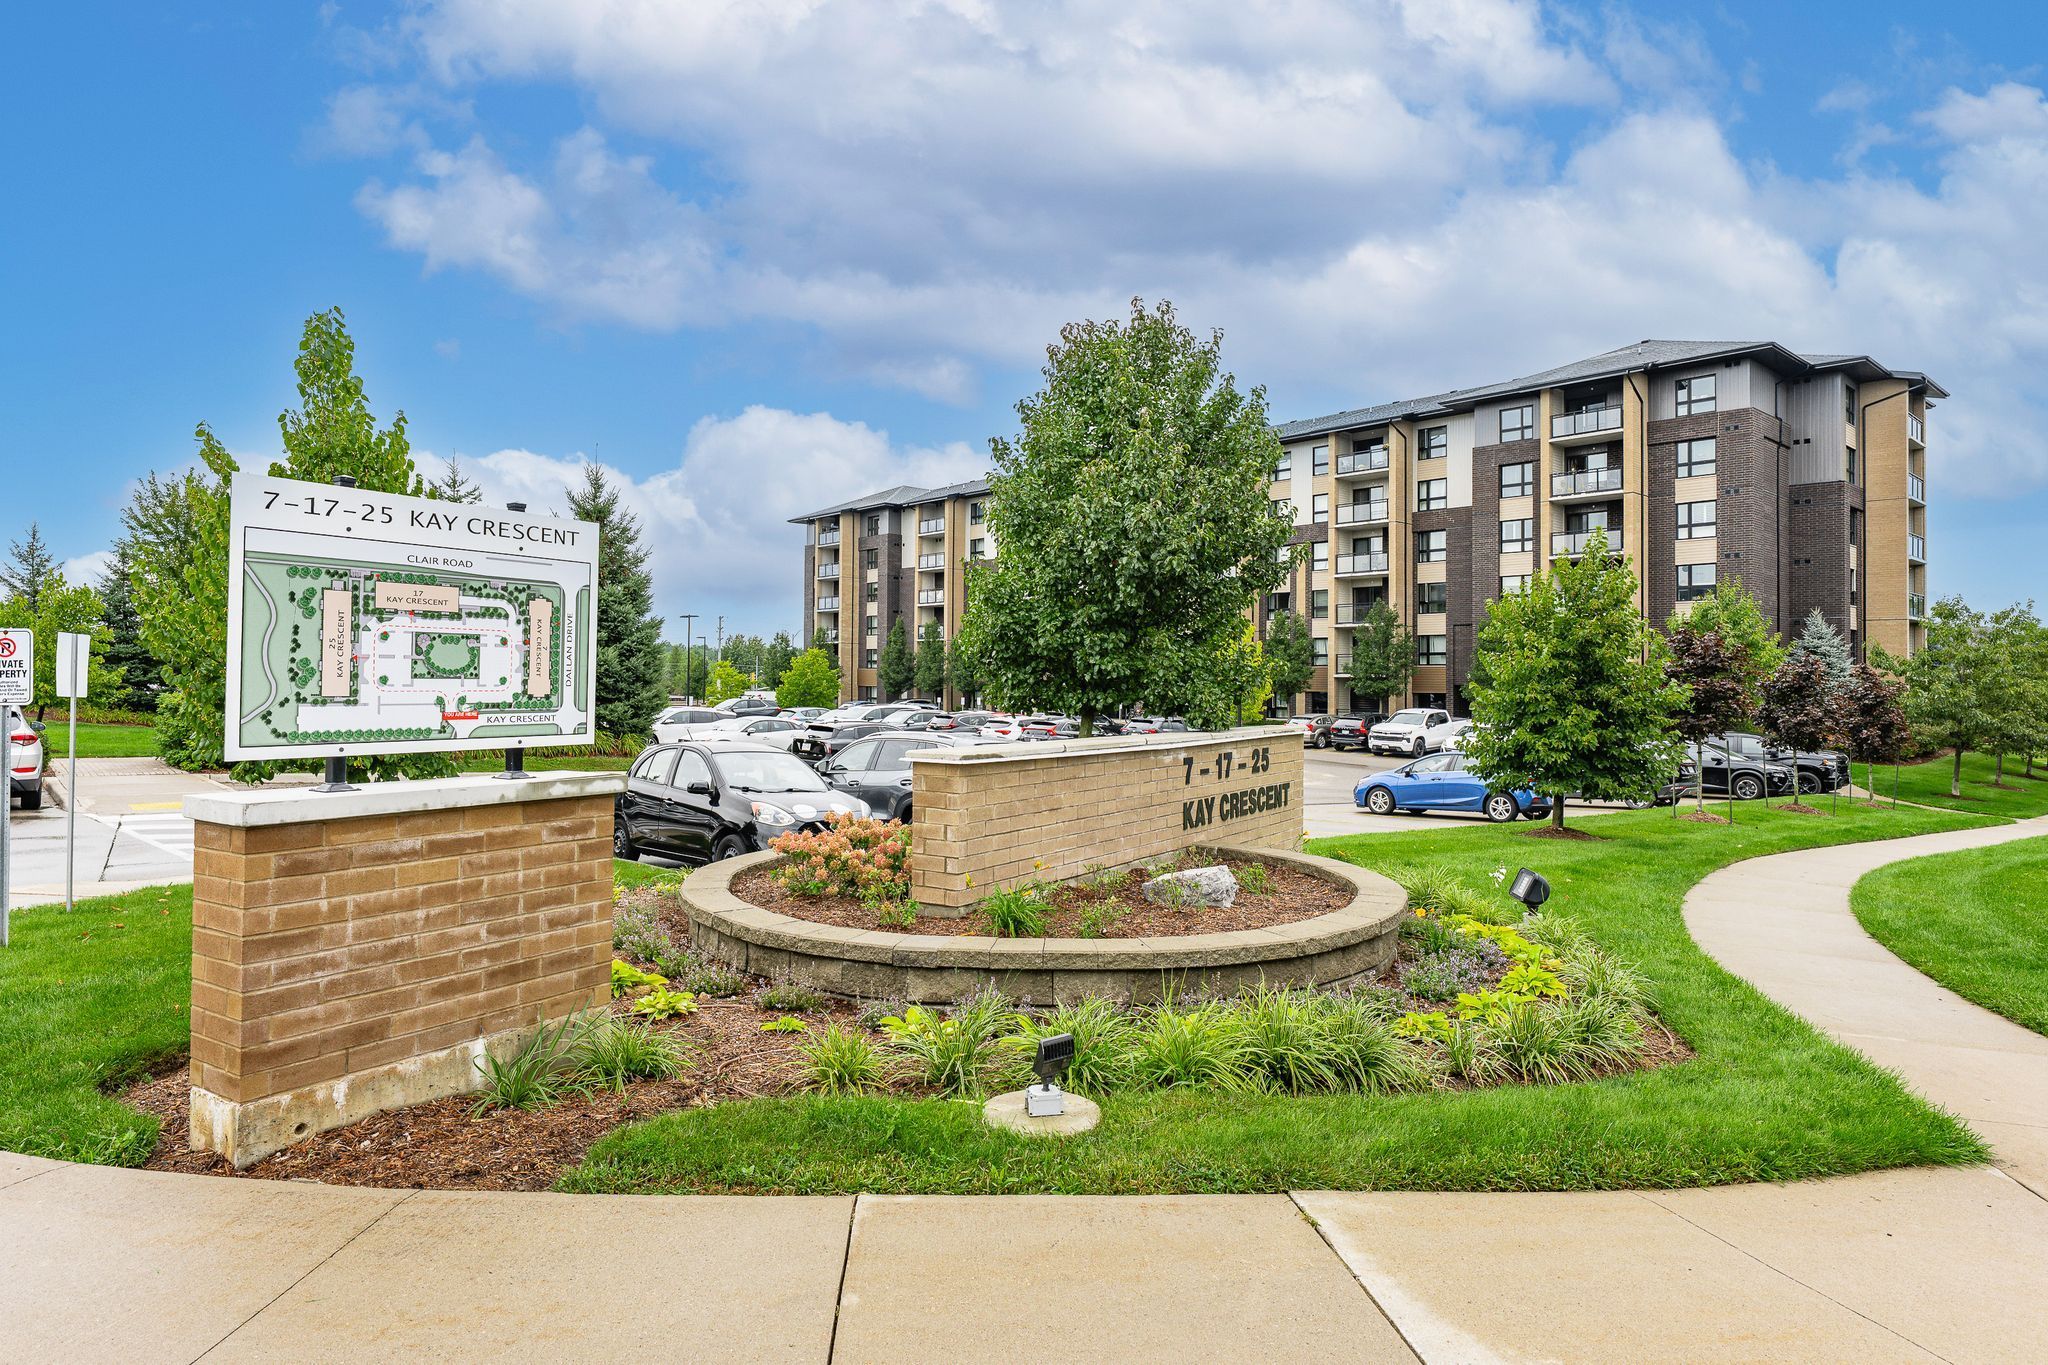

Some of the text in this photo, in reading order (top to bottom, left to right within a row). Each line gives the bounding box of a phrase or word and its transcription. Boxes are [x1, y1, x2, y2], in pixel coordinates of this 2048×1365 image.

[263, 491, 580, 546] 7-17-25 KAY CRESCENT
[407, 554, 473, 568] CLAIR ROAD
[405, 597, 449, 606] CRESCENT
[329, 638, 336, 649] 25
[337, 609, 345, 657] CRESCENT
[565, 612, 574, 687] DALLAN DRIVE
[0, 659, 23, 668] VATE
[486, 714, 557, 724] KAY CRESCENT
[1183, 756, 1194, 785] 7
[1215, 752, 1233, 780] 17
[1251, 747, 1270, 774] 25
[1183, 782, 1291, 831] KAY CRESCENT
